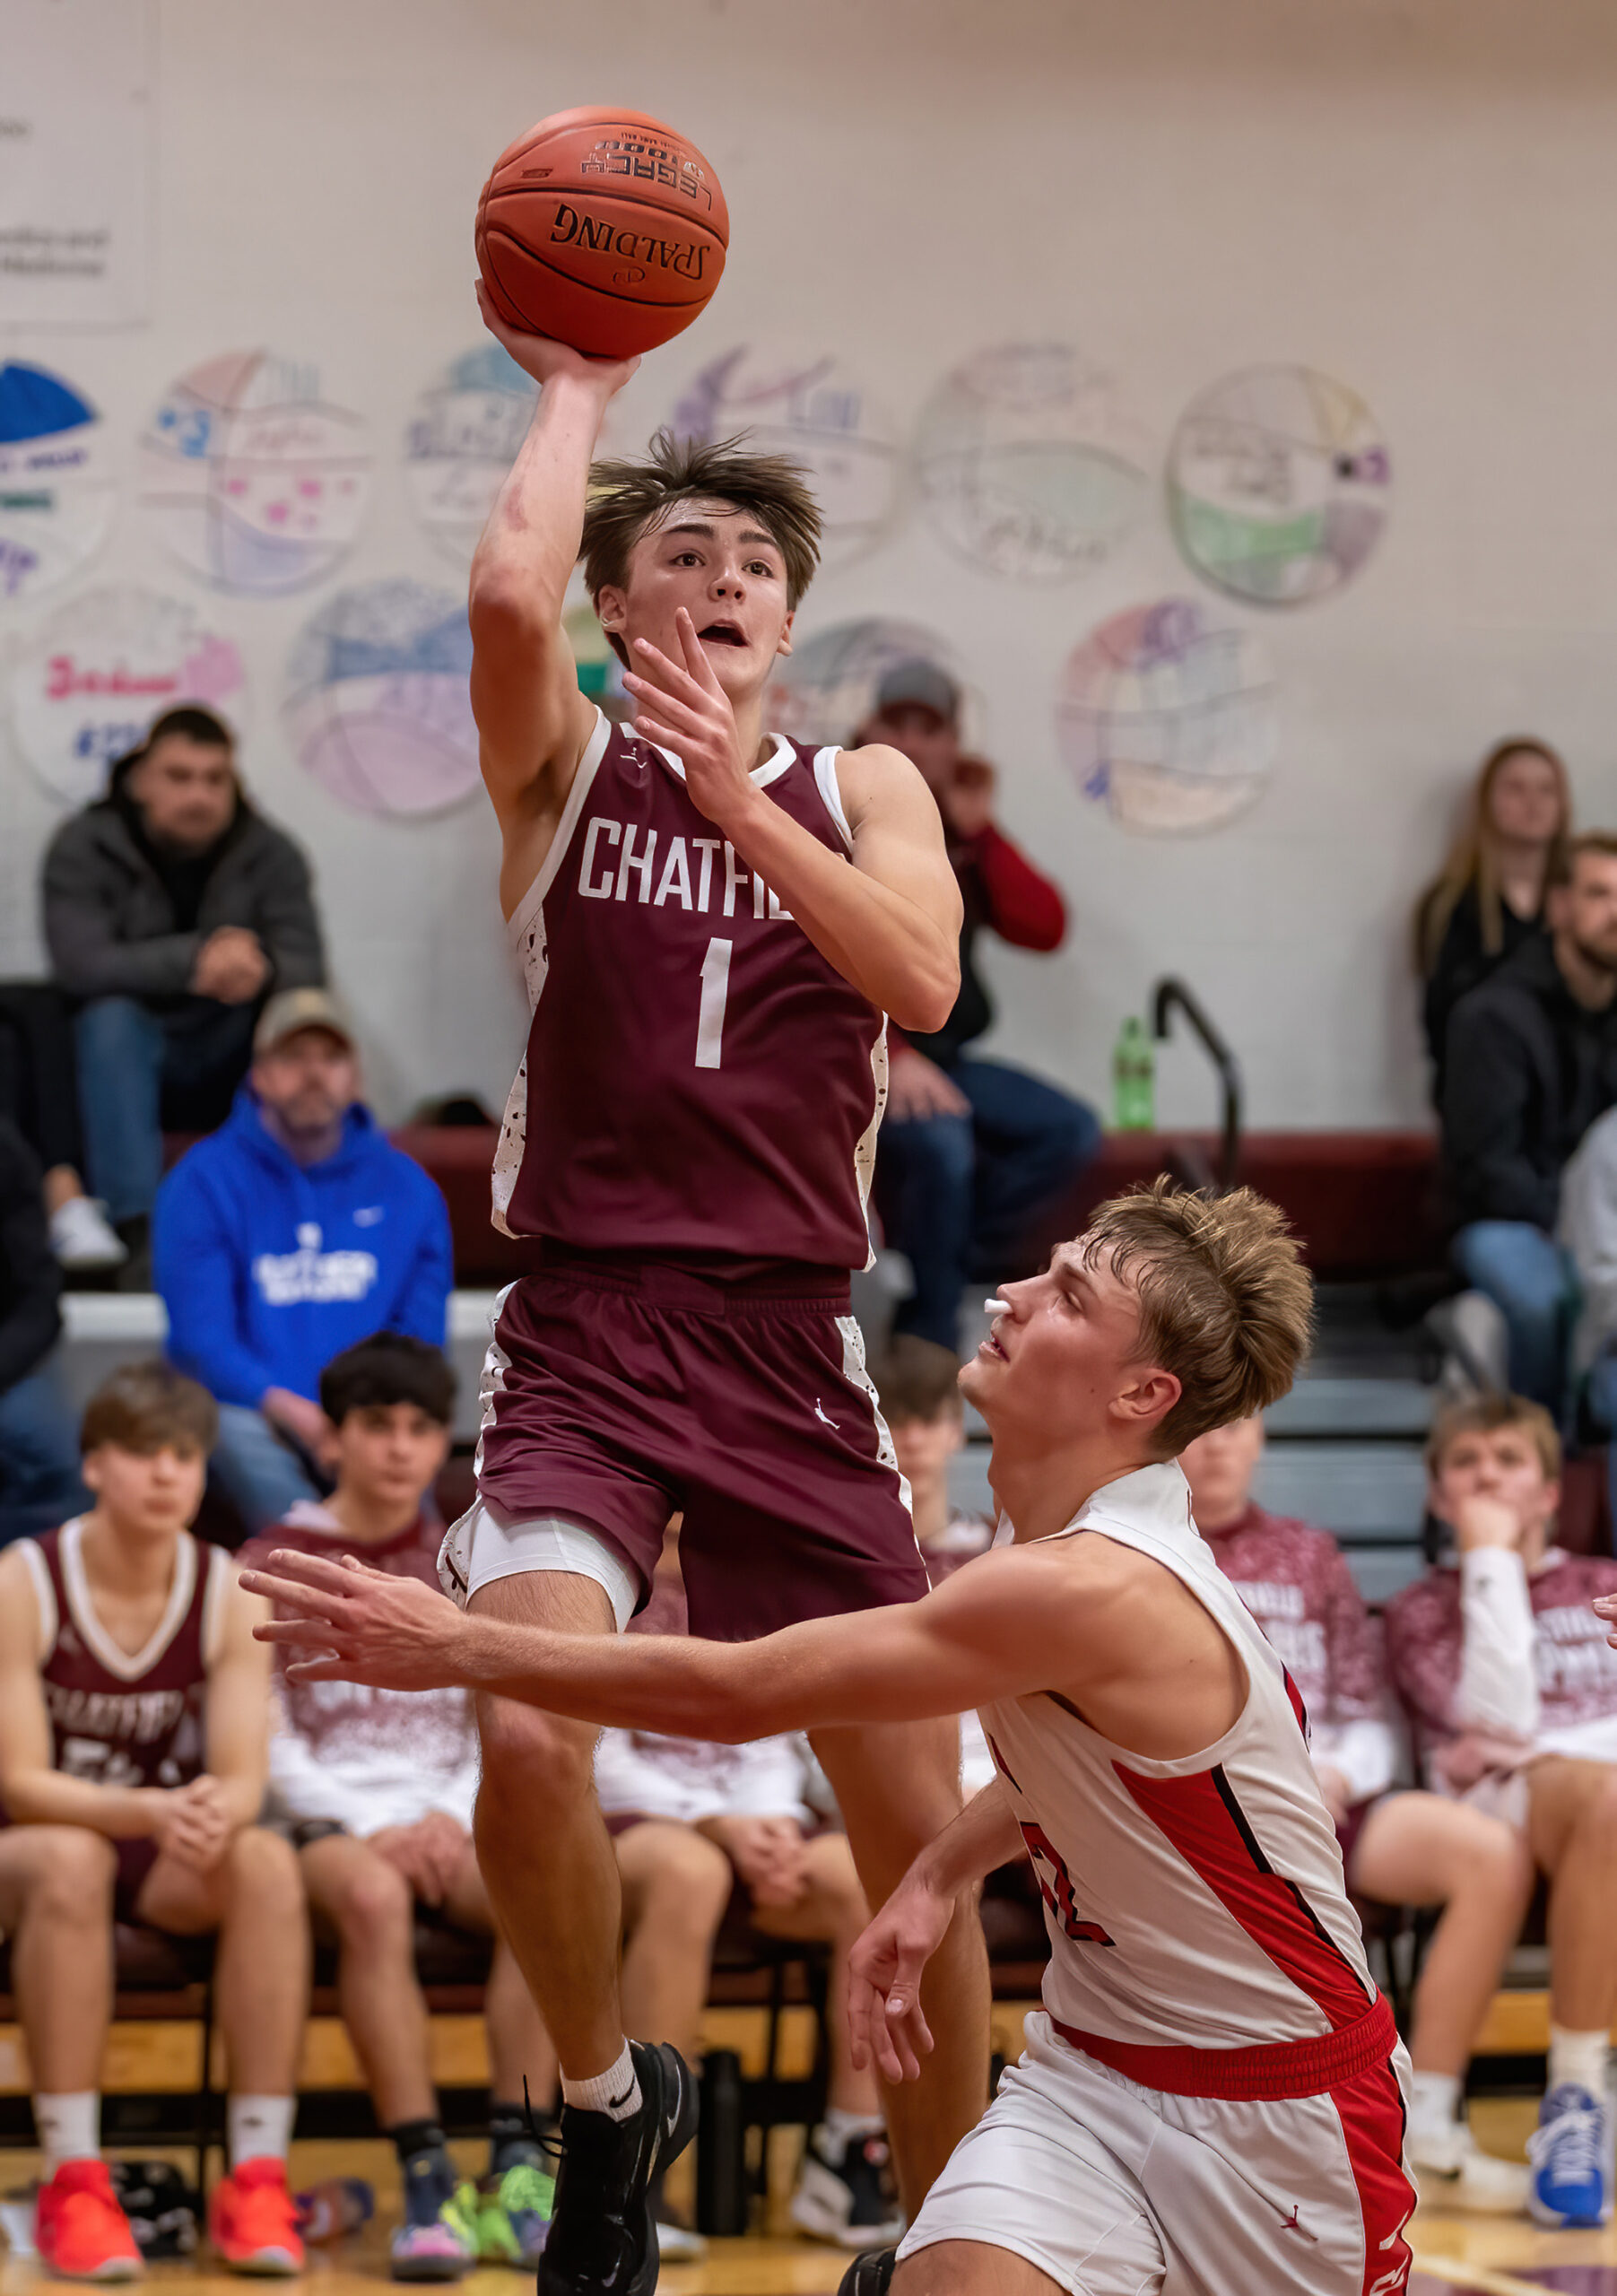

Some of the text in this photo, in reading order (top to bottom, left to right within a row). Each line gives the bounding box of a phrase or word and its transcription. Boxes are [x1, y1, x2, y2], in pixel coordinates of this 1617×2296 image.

[580, 151, 712, 212] LEGACY
[550, 203, 710, 280] SPALDING
[694, 936, 734, 1070] 1
